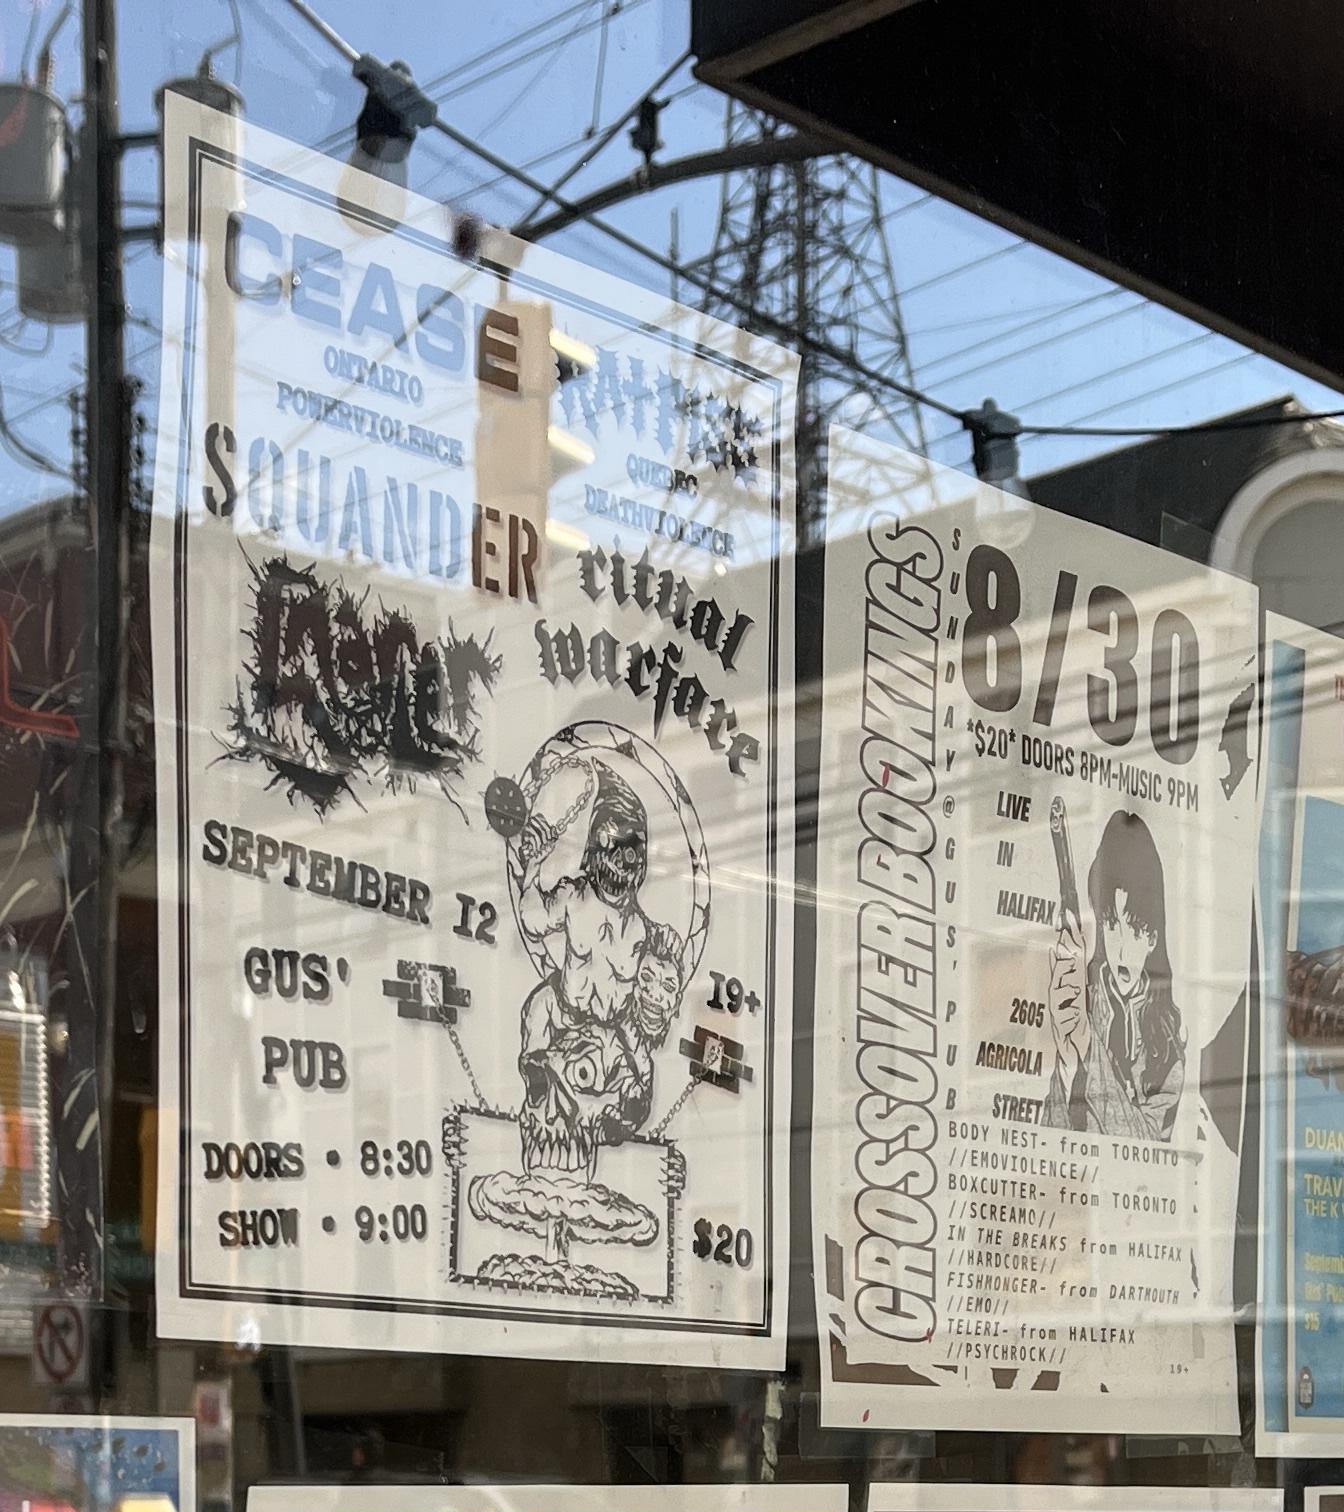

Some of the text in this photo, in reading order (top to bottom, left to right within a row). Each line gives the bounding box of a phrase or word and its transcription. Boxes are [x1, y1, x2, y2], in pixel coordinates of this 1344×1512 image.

[225, 211, 520, 394] CEASE
[323, 345, 423, 402] ONTARIO
[276, 382, 464, 469] POWERVIOLENCE
[203, 422, 541, 604] SQUANDER
[576, 535, 755, 673] ritual
[962, 544, 1200, 765] 8/30
[535, 619, 760, 777] warfare
[1022, 738, 1074, 777] DOORS
[1167, 778, 1199, 812] 9PM
[996, 792, 1031, 822] LIVE
[997, 841, 1014, 867] IN
[202, 819, 500, 944] SEPTEMBER 12
[855, 510, 944, 1343] CROSSOVER BOOKINGS
[996, 889, 1056, 926] HALIFAX
[243, 947, 350, 1001] GUS'
[706, 970, 760, 1014] 19+
[1010, 998, 1045, 1028] 2605
[262, 1036, 348, 1090] PUB
[976, 1041, 1043, 1076] AGRICOLA
[992, 1093, 1043, 1124] STREET
[203, 1138, 432, 1182] DOORS 8:30
[948, 1121, 1179, 1167] BODY from TORONTO
[1060, 1187, 1177, 1215] from TORONTO
[1304, 1199, 1326, 1217] THE
[218, 1203, 429, 1249] SHOW 9:00
[693, 1217, 754, 1267] $20
[947, 1225, 1183, 1263] IN THE BREAKS HALIFAX
[1110, 1285, 1180, 1305] DARTMOUTH
[1069, 1328, 1135, 1345] HALIFAX
